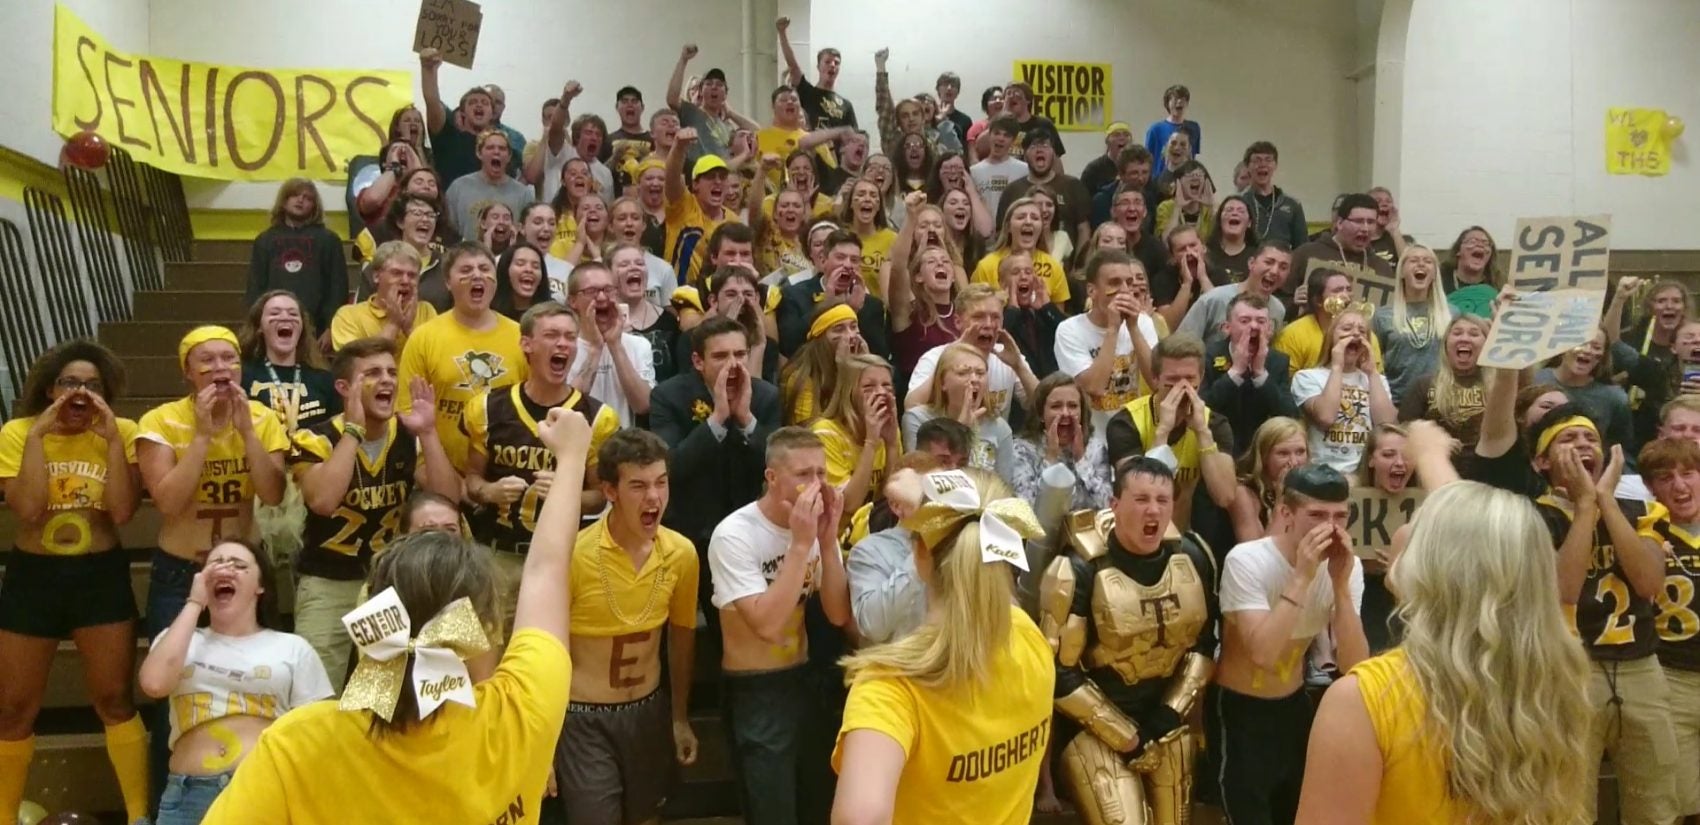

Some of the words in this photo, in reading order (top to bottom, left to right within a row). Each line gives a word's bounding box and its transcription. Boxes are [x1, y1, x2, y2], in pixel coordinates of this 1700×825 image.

[421, 31, 469, 57] LOSS
[1022, 64, 1105, 95] VISITOR
[74, 36, 391, 173] SENIORS
[1033, 95, 1104, 126] ECTION
[1567, 219, 1608, 287] ALL
[46, 461, 107, 484] USVILL
[201, 479, 241, 504] 36
[986, 543, 1020, 560] Kate
[1139, 593, 1182, 650] T
[608, 630, 652, 690] E
[419, 674, 466, 701] Tayler
